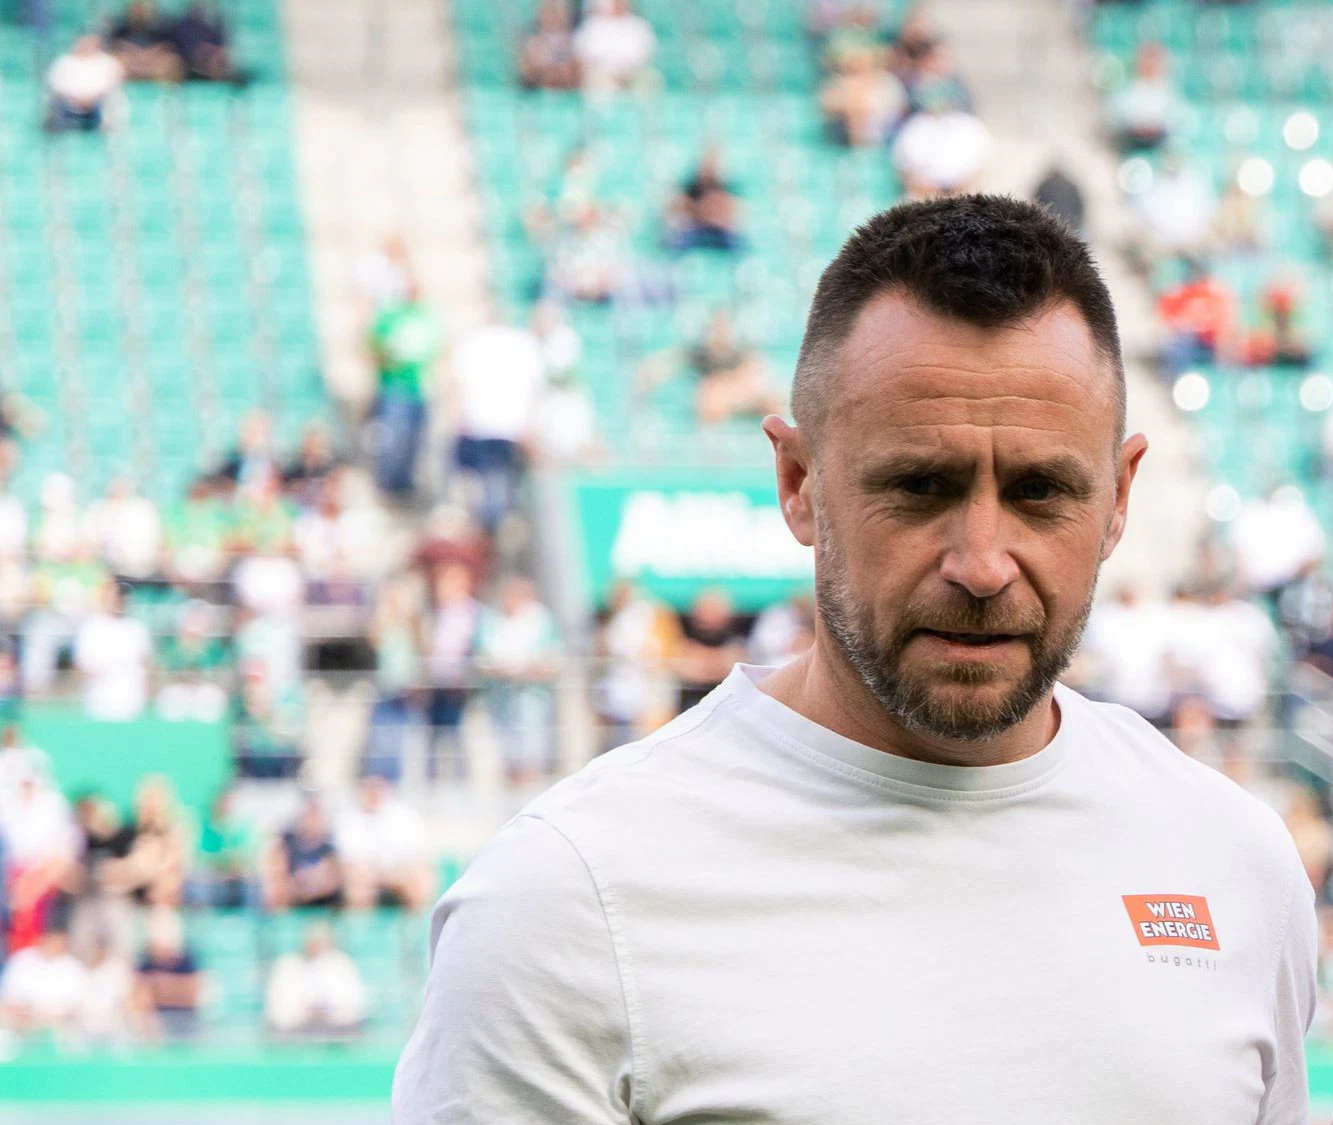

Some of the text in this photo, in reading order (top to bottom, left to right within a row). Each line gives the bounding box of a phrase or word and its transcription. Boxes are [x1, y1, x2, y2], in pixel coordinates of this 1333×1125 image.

[1145, 902, 1196, 919] WIEN
[1139, 921, 1212, 941] ENERGIE
[1147, 953, 1217, 971] bugatti
